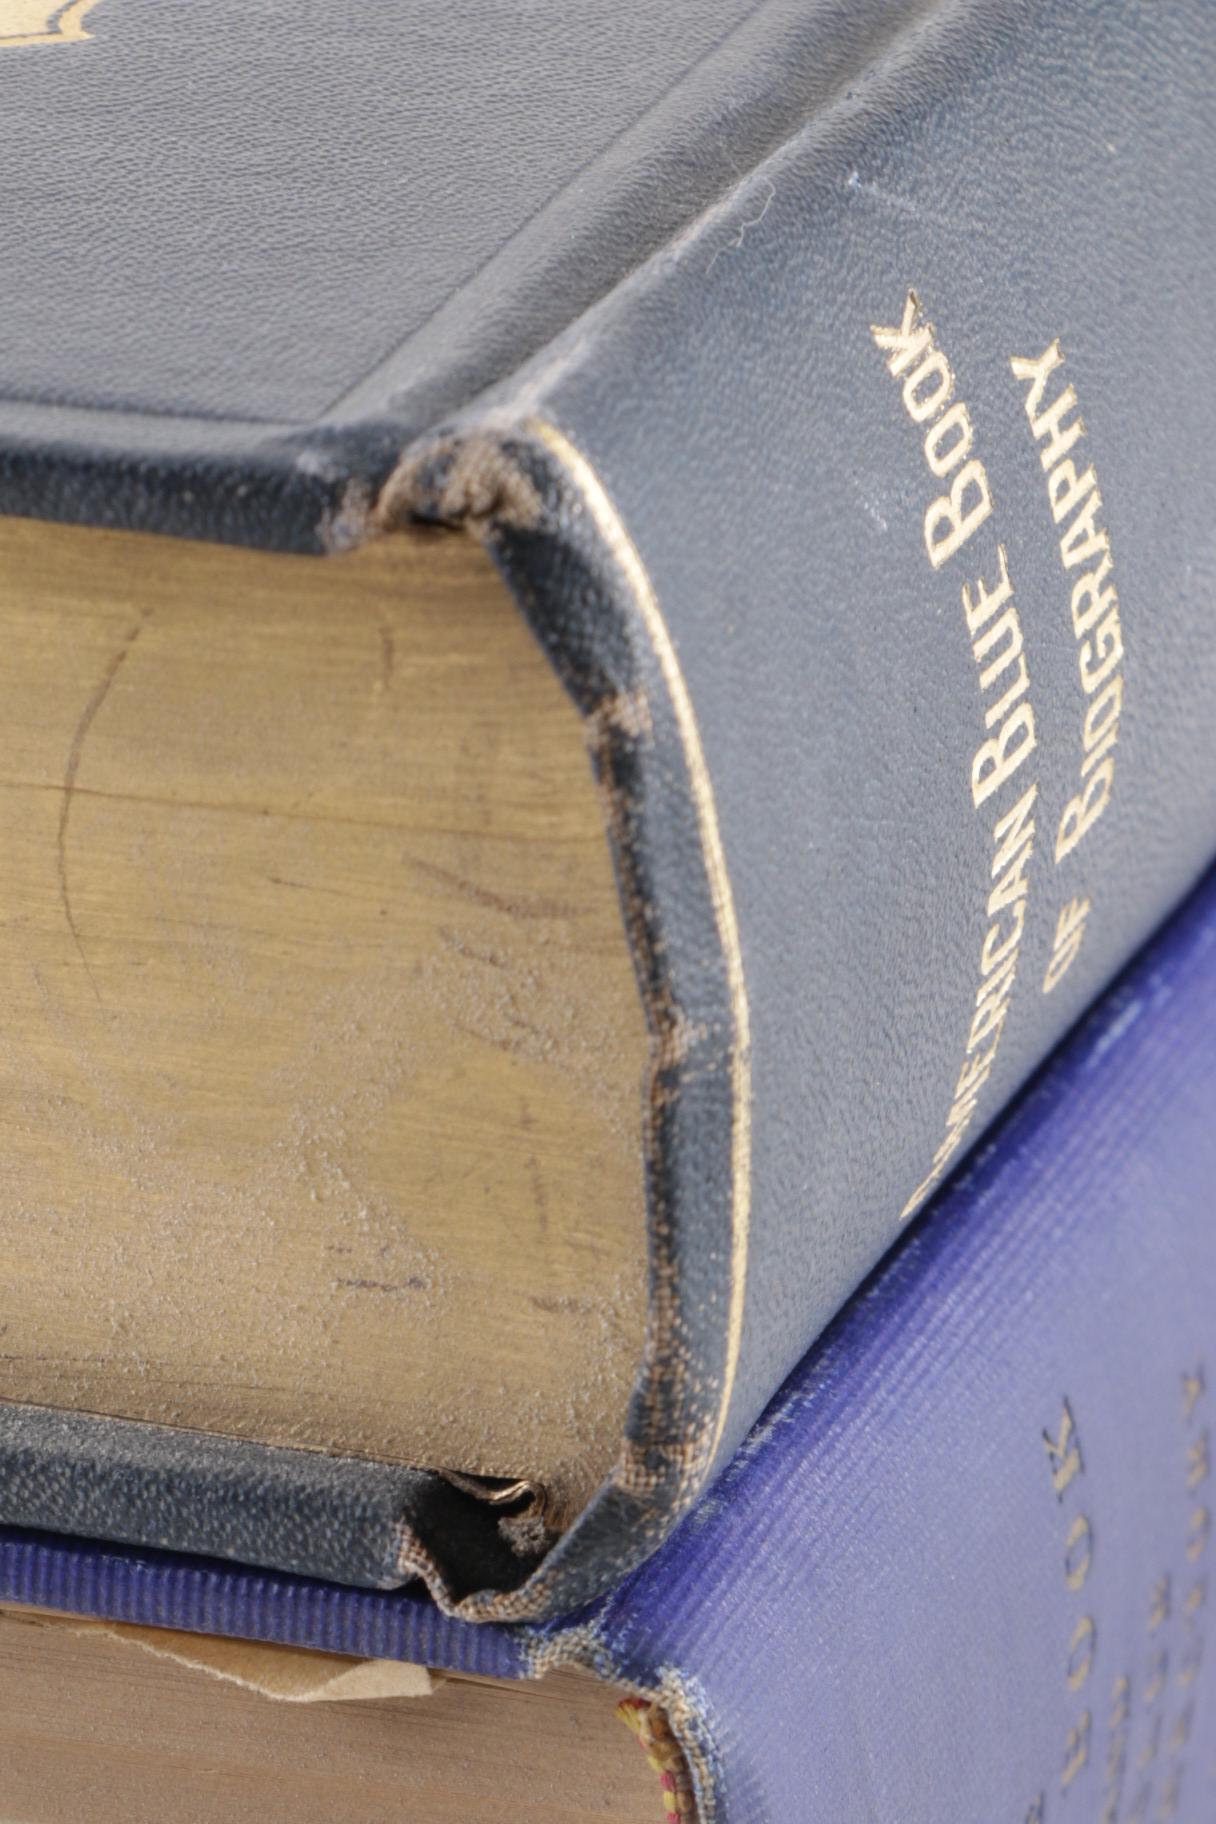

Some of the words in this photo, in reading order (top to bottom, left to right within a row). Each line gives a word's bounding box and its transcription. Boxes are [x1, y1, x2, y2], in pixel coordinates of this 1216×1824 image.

[871, 289, 993, 569] BOOK
[962, 543, 1036, 808] BLUE
[1010, 336, 1124, 864] BIOGRAPHY
[899, 782, 1038, 1220] AMERICAN
[1043, 897, 1090, 994] OF
